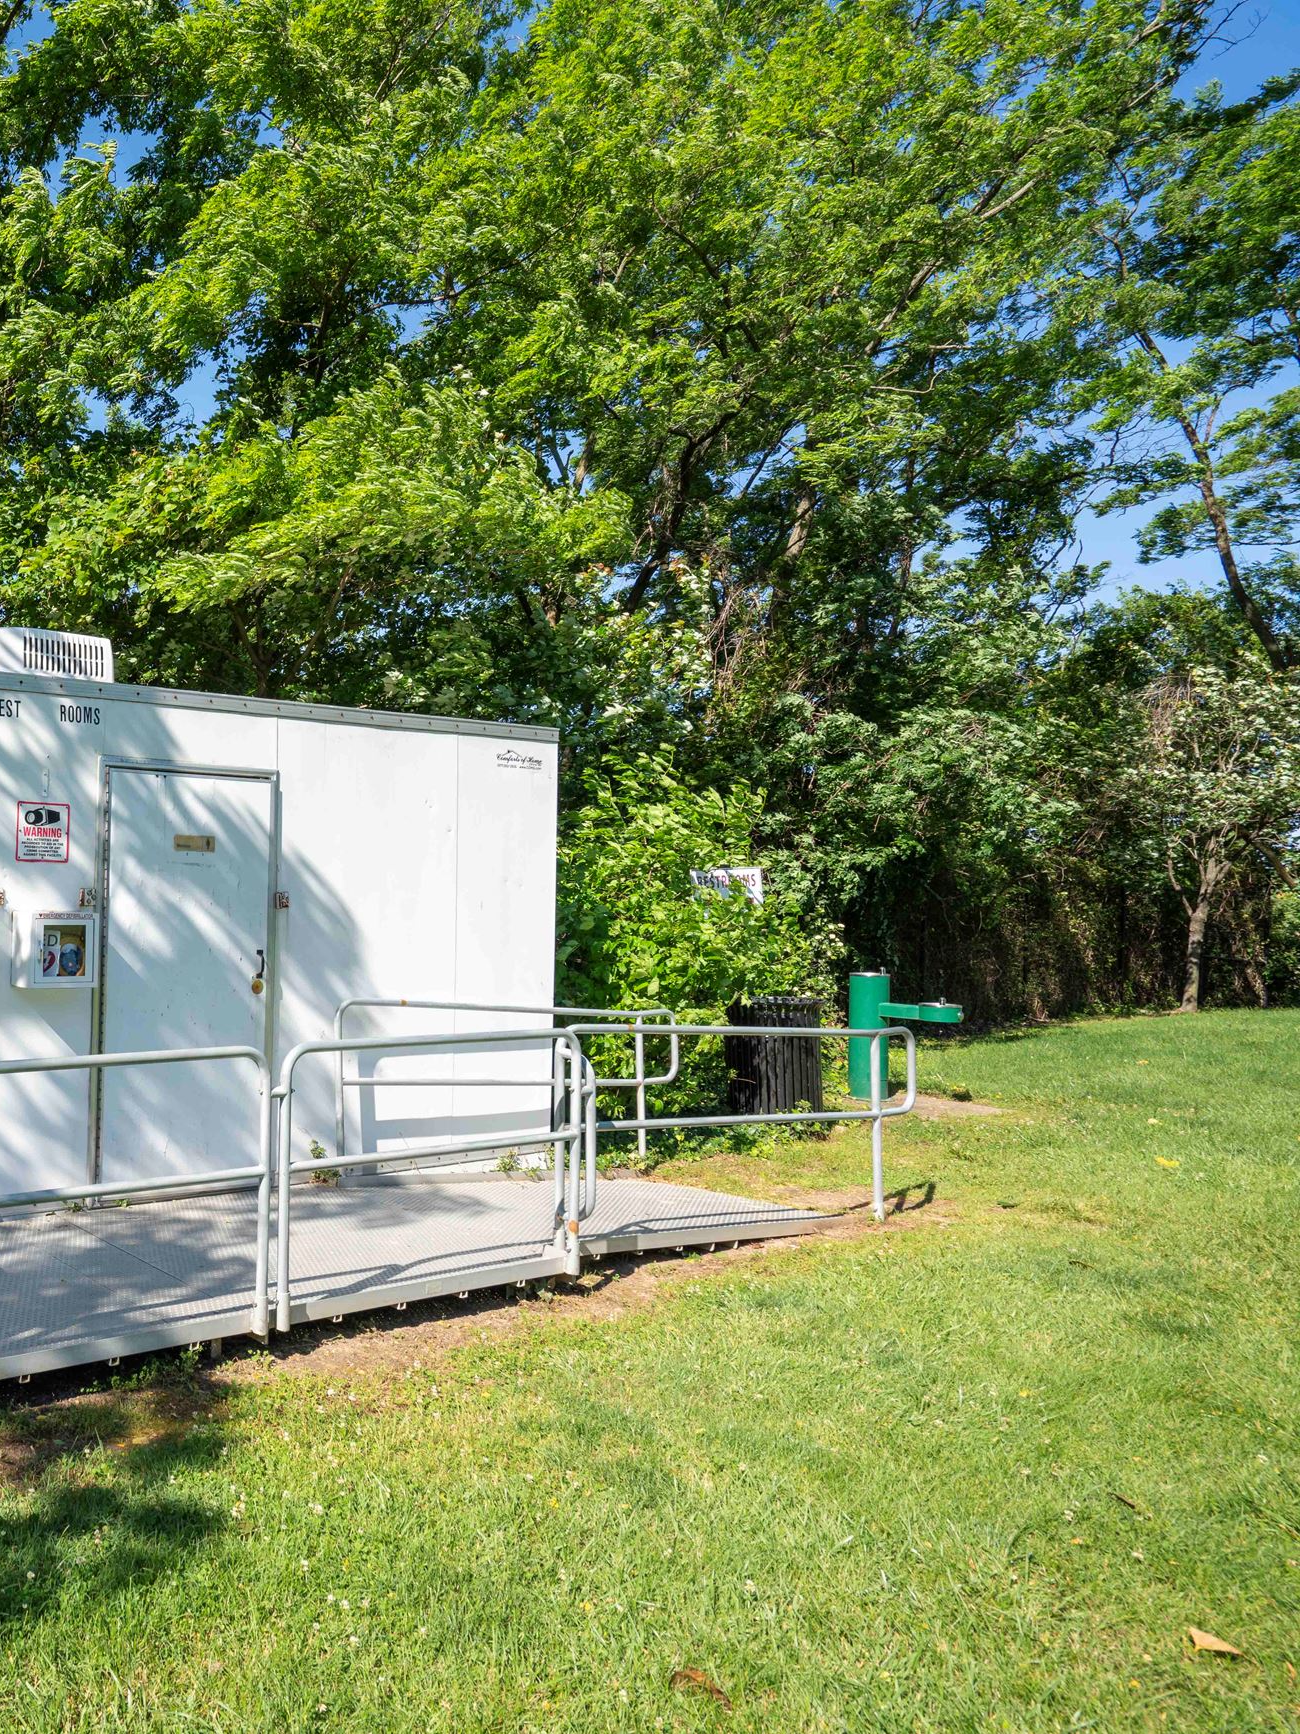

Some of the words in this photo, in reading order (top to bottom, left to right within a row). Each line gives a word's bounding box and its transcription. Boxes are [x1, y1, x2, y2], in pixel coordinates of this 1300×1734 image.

[60, 705, 100, 725] ROOMS
[23, 827, 62, 838] WARNING
[697, 874, 756, 888] RESTROMS
